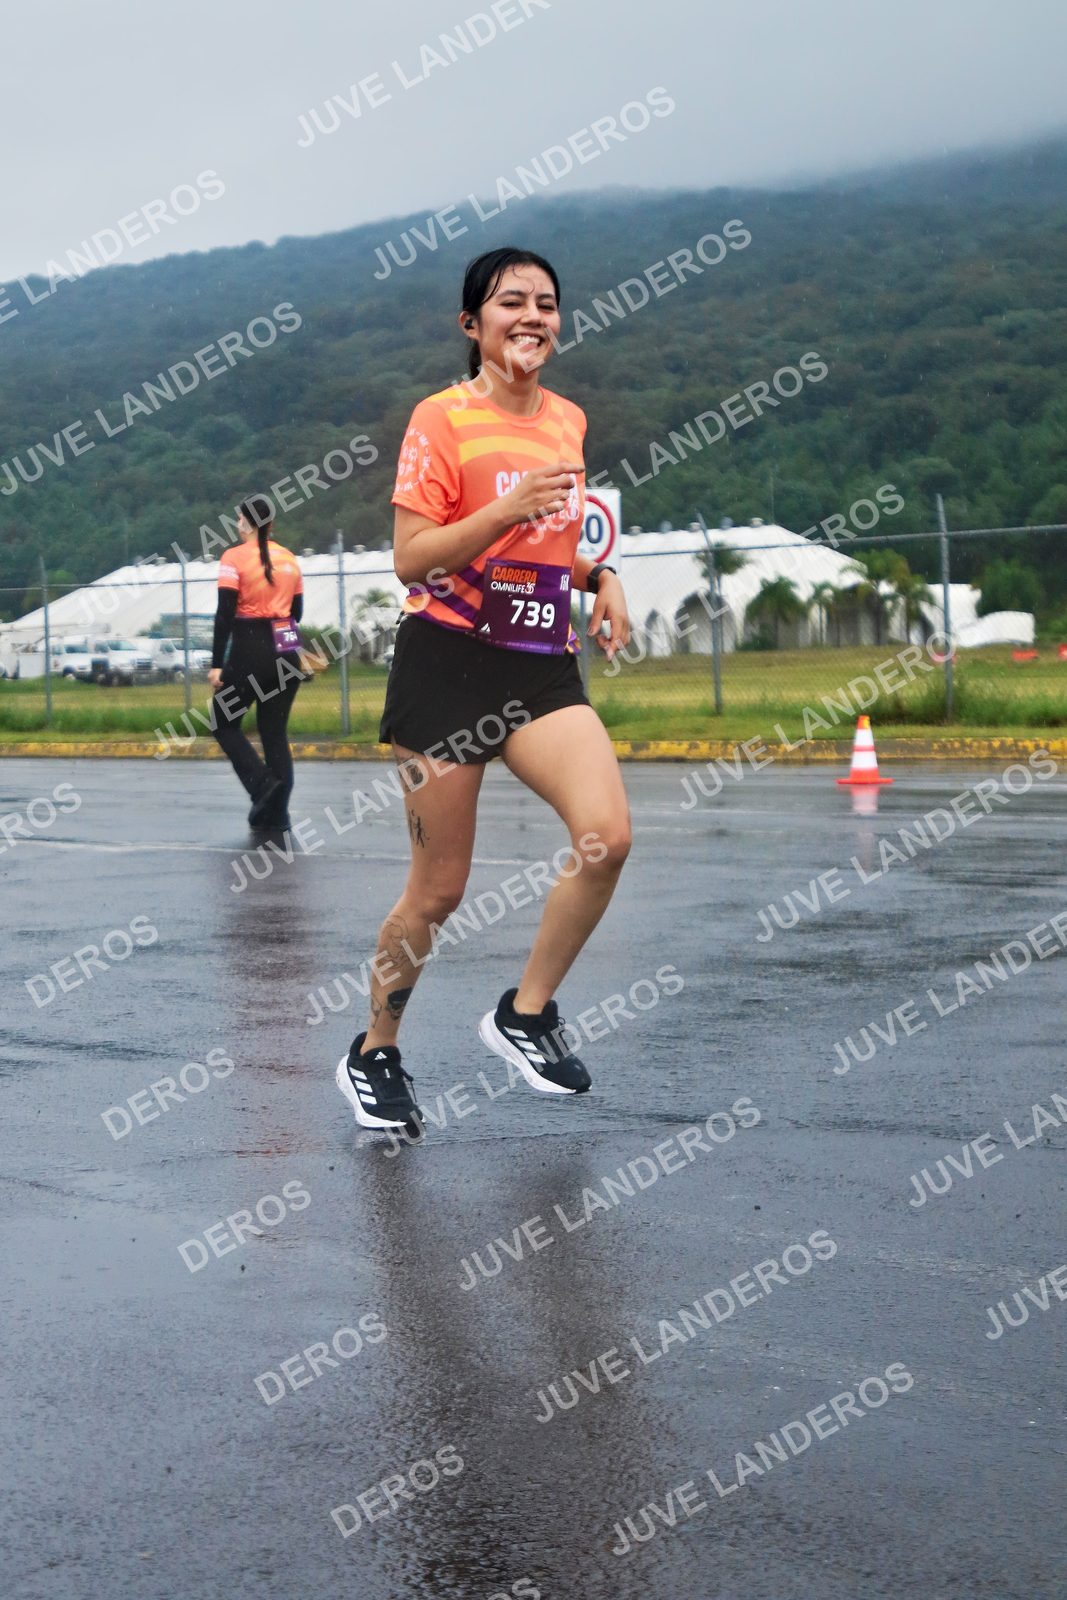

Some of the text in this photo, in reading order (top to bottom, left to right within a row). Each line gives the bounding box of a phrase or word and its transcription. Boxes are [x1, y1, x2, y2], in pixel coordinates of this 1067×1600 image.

[491, 566, 538, 583] CARRERA
[491, 581, 525, 593] OMNILIFE
[510, 599, 555, 628] 739
